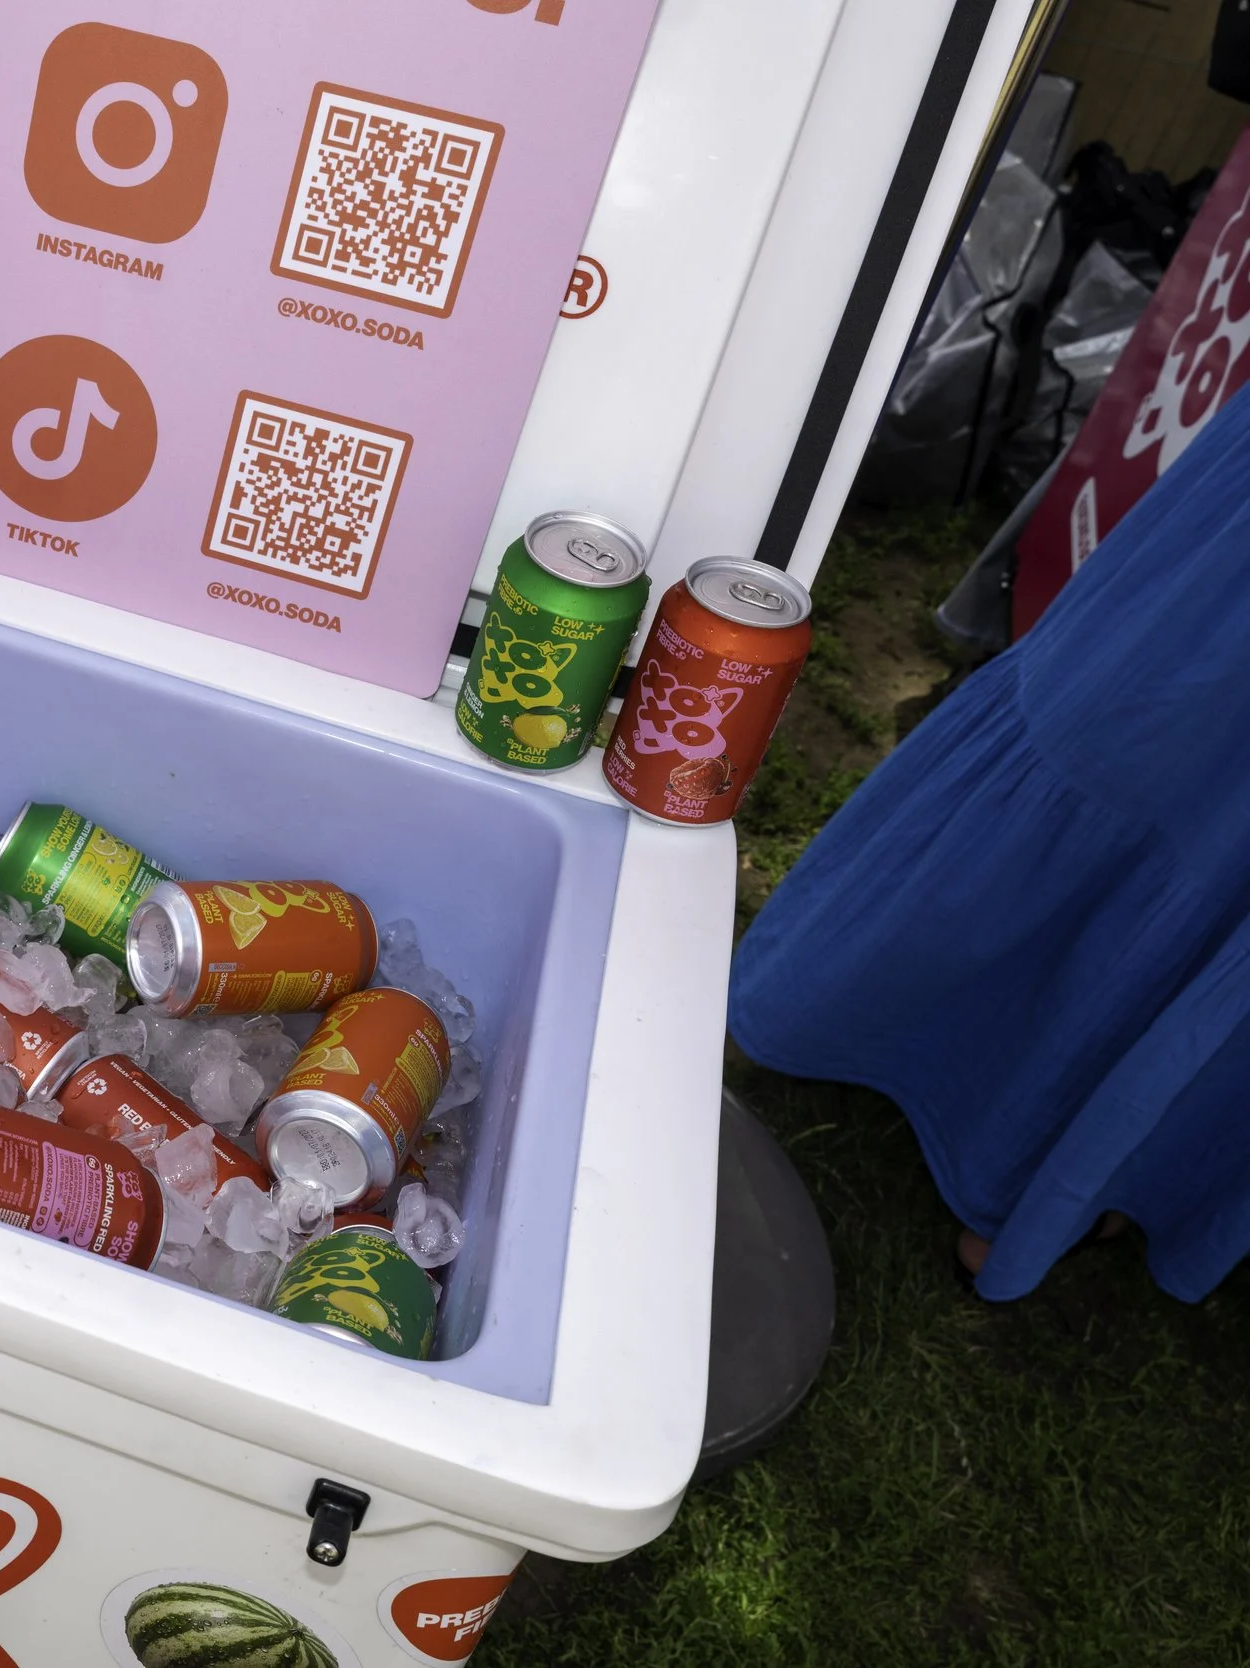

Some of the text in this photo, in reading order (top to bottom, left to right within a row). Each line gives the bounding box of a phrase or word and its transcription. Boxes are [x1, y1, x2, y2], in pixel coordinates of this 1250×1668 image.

[36, 233, 164, 281] INSTAGRAM
[277, 297, 424, 350] @XOXO.SODA
[6, 523, 81, 557] TIKTOK
[206, 582, 342, 633] @XOXO.SODA
[498, 585, 513, 611] FIBRE
[500, 574, 538, 615] PREBIOTIC
[551, 627, 593, 641] SUGAR
[554, 616, 583, 629] LOW
[656, 632, 676, 655] FIBRE
[660, 619, 703, 660] PREBIOTIC
[717, 670, 762, 685] SUGAR
[722, 660, 752, 673] LOW
[458, 710, 484, 743] CALORIE
[510, 743, 549, 755] PLANT
[615, 743, 636, 769] BERRIES
[617, 736, 626, 750] RED
[507, 752, 547, 764] BASED
[610, 754, 623, 775] LOW
[607, 763, 638, 797] CALORIE
[664, 805, 704, 818] BASED
[667, 795, 708, 808] PLANT
[41, 826, 63, 858] SHOW
[56, 825, 75, 852] SOME
[42, 862, 71, 905] SPARKLING
[68, 837, 85, 863] GINGER
[195, 893, 214, 924] BASED
[208, 893, 223, 924] PLANT
[326, 892, 346, 923] SUGAR
[335, 892, 352, 911] LOW
[110, 1061, 129, 1078] VEGAN
[132, 1079, 167, 1109] VEGETARIAN
[170, 1110, 193, 1130] GLUTEN
[118, 1103, 143, 1127] RED
[78, 1171, 94, 1238] PREBIOTIC FIBRE
[88, 1173, 100, 1229] PLANT-BASED
[93, 1163, 115, 1252] SPARKLING RED
[356, 1239, 400, 1260] SUGAR
[358, 1234, 388, 1246] LOW
[326, 1314, 372, 1337] BASED
[329, 1309, 375, 1329] PLANT
[416, 1592, 504, 1628] PREB
